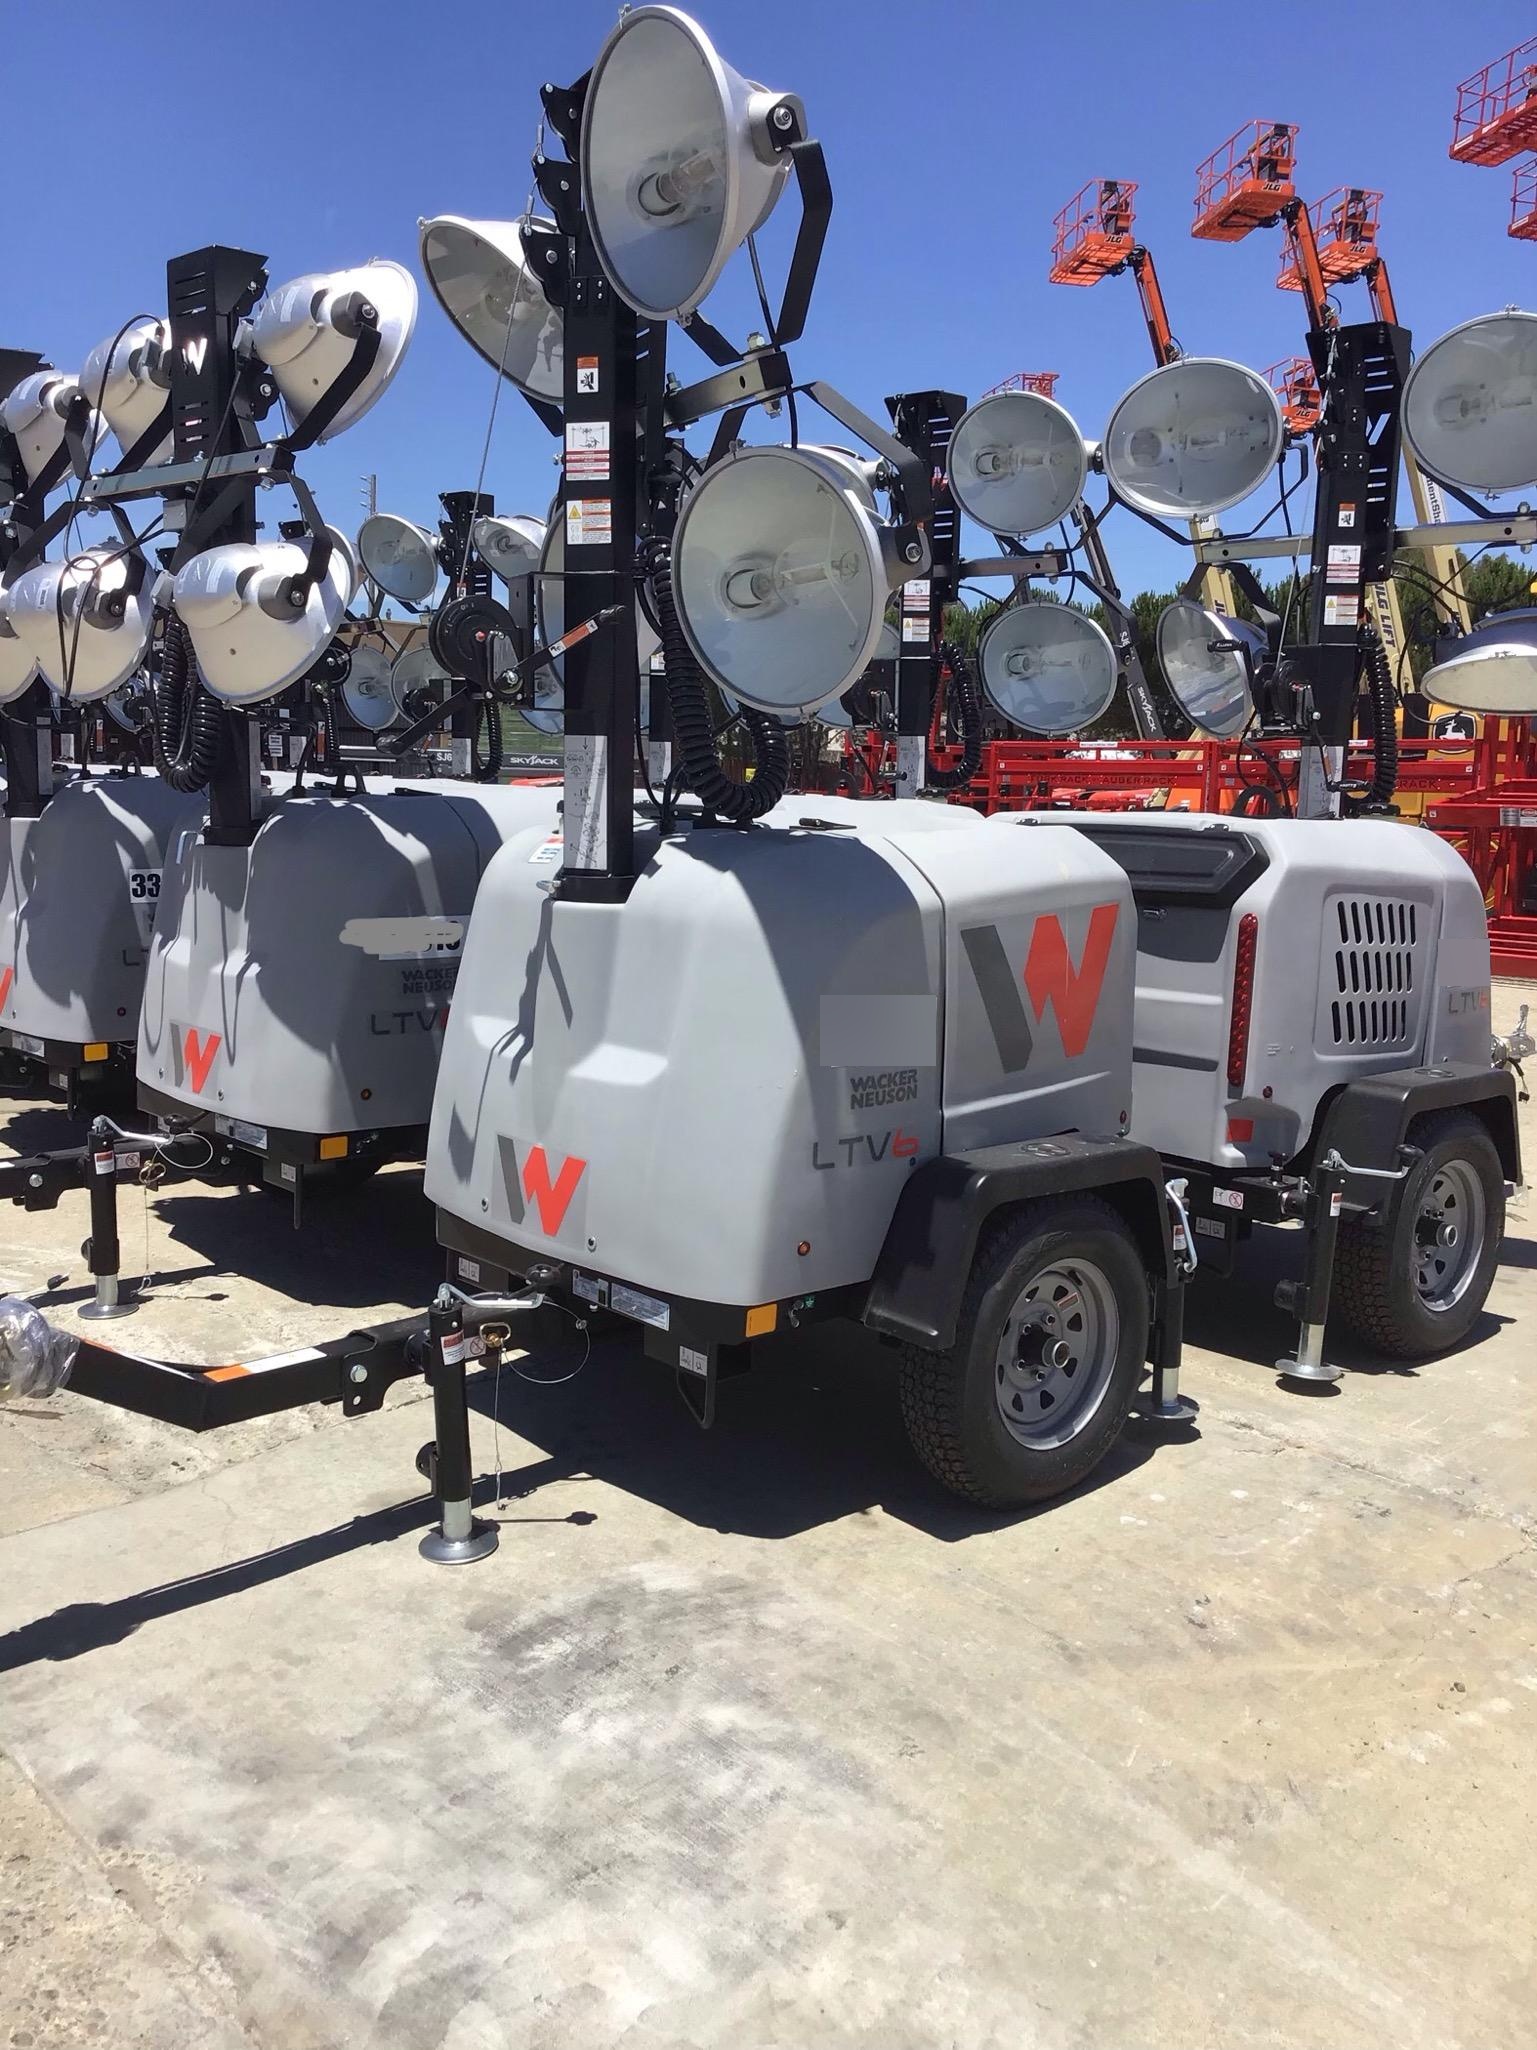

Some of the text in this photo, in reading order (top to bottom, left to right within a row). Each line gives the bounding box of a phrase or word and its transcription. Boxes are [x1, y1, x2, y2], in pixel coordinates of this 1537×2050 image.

[1263, 182, 1282, 192] JLG
[1105, 235, 1123, 244] JLG
[1350, 245, 1366, 254] JLG
[1380, 614, 1395, 648] LIFT
[510, 755, 559, 766] SKYJACK
[131, 873, 161, 898] 33
[402, 980, 453, 995] NEUSO
[850, 1068, 918, 1093] WACKER
[850, 1084, 918, 1110] NEUSON
[812, 1128, 920, 1170] LTV6
